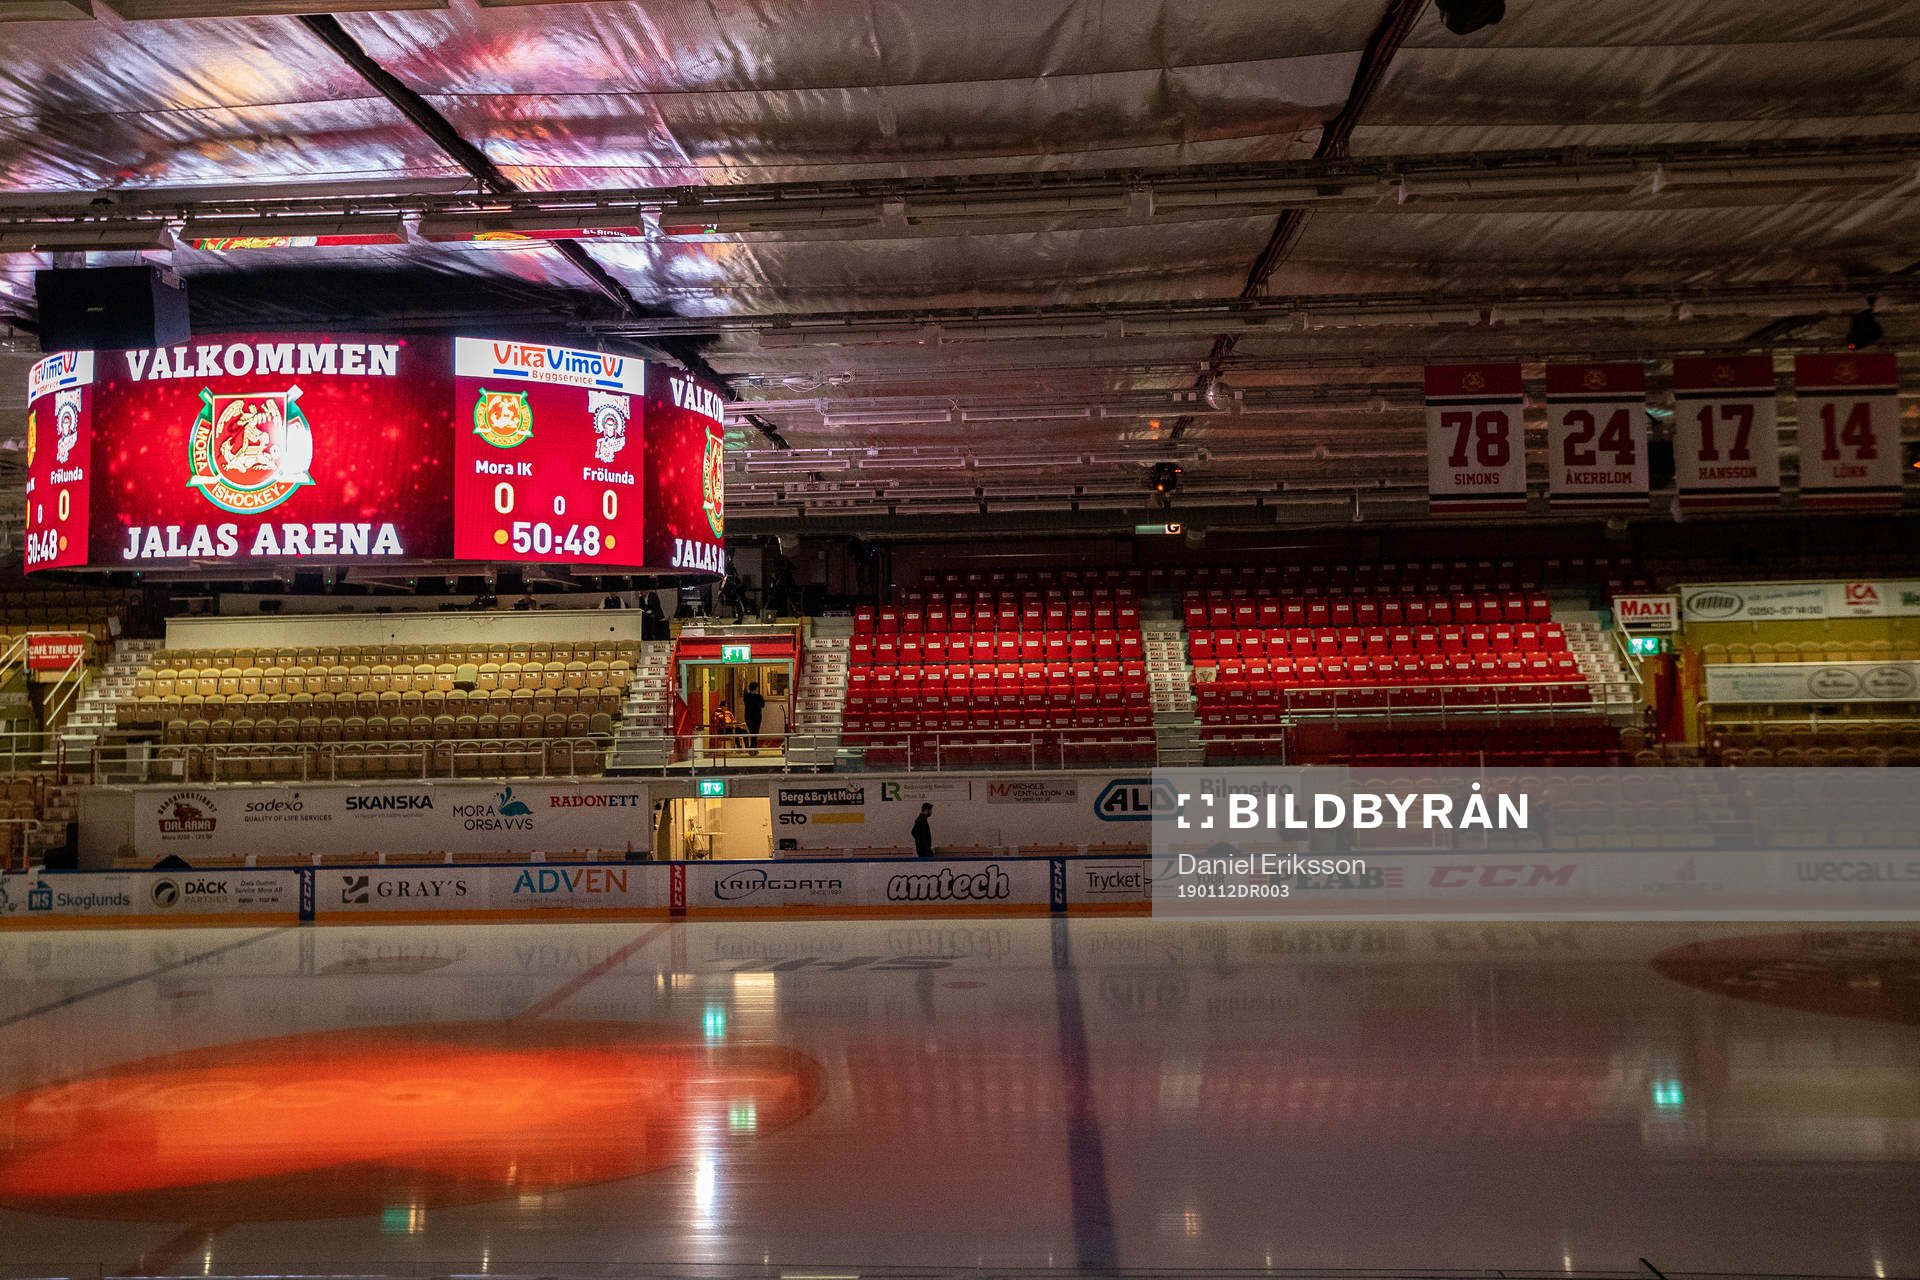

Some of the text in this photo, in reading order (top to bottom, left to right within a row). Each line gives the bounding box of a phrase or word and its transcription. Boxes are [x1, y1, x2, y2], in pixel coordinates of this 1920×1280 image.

[532, 370, 593, 385] Byggservice
[1440, 411, 1510, 467] 78
[1563, 409, 1636, 467] 24
[1696, 404, 1754, 461] 17
[1820, 403, 1877, 461] 14
[196, 427, 211, 471] MORA
[475, 460, 533, 477] Mora IK
[583, 467, 635, 485] Frölunda
[1566, 469, 1632, 485] ÅKERBLOM
[1699, 466, 1758, 480] HANSSON
[1454, 472, 1500, 485] SIMONS
[59, 489, 70, 521] 0
[494, 482, 514, 514] 0
[553, 496, 566, 515] 0
[602, 489, 618, 520] 0
[124, 523, 403, 559] JALAS ARENA
[512, 521, 601, 556] 50:48
[672, 538, 717, 574] JALAS
[1845, 583, 1879, 600] ICA
[1620, 600, 1671, 616] MAXI
[49, 645, 67, 655] TIME
[68, 645, 84, 655] OUT
[1200, 778, 1292, 798] Bilmetro
[245, 794, 303, 812] sodexo
[346, 795, 434, 810] SKANSKA
[550, 795, 639, 808] RADONETT
[453, 805, 495, 817] MORA
[779, 810, 808, 825] sto
[464, 819, 534, 831] ORSA VVS
[513, 869, 628, 893] ADVEN
[715, 879, 842, 889] KRINGDATA
[887, 865, 1010, 900] amtech
[1085, 872, 1140, 890] Trycket
[1429, 864, 1577, 888] CCM
[185, 879, 227, 894] DÄCK
[57, 893, 130, 908] Skoglunds
